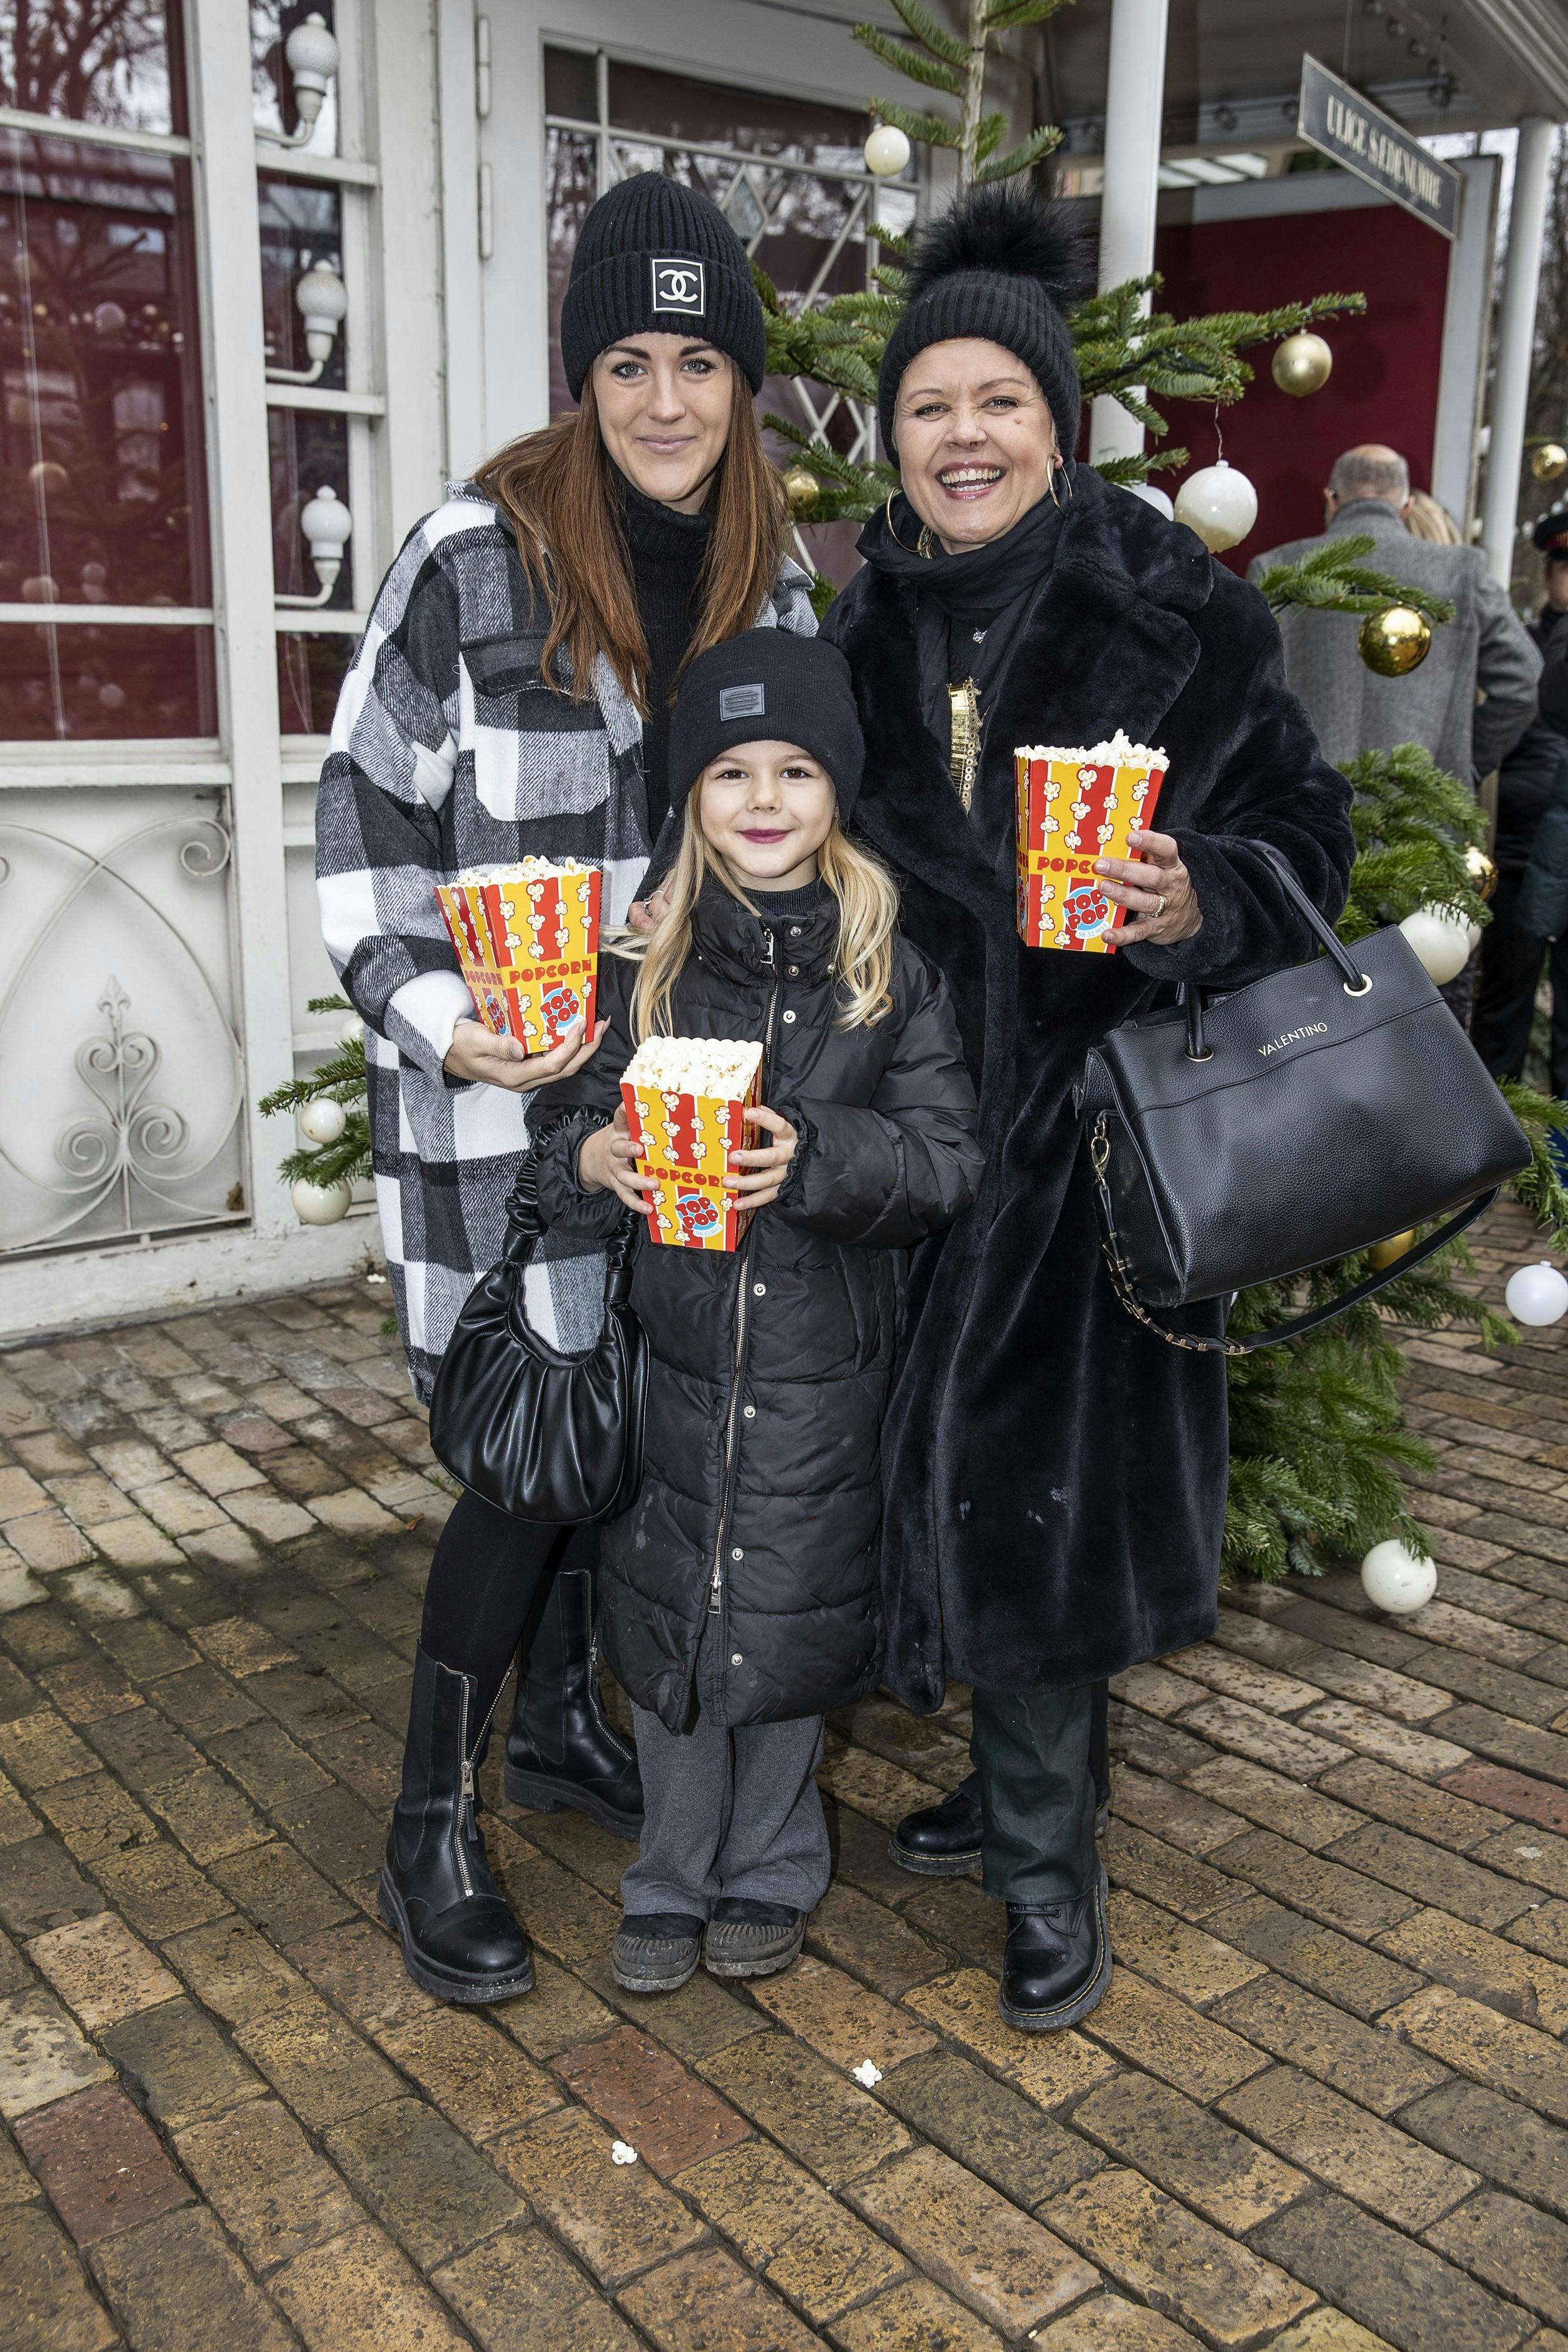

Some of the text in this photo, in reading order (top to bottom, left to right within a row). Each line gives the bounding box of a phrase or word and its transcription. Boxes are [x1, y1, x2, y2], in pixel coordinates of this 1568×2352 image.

[1063, 890, 1103, 913] TOP
[1068, 904, 1108, 930] POP
[465, 970, 502, 986] POPCORN
[510, 959, 592, 984] POPCORN
[487, 997, 500, 1019] TOP
[540, 987, 573, 1015] TOP
[493, 1011, 505, 1033] POP
[546, 1002, 579, 1029] POP
[1258, 1022, 1328, 1057] VALENTINO
[644, 1165, 725, 1188] POPCOR
[675, 1197, 711, 1216] TOP
[682, 1209, 718, 1230] POP
